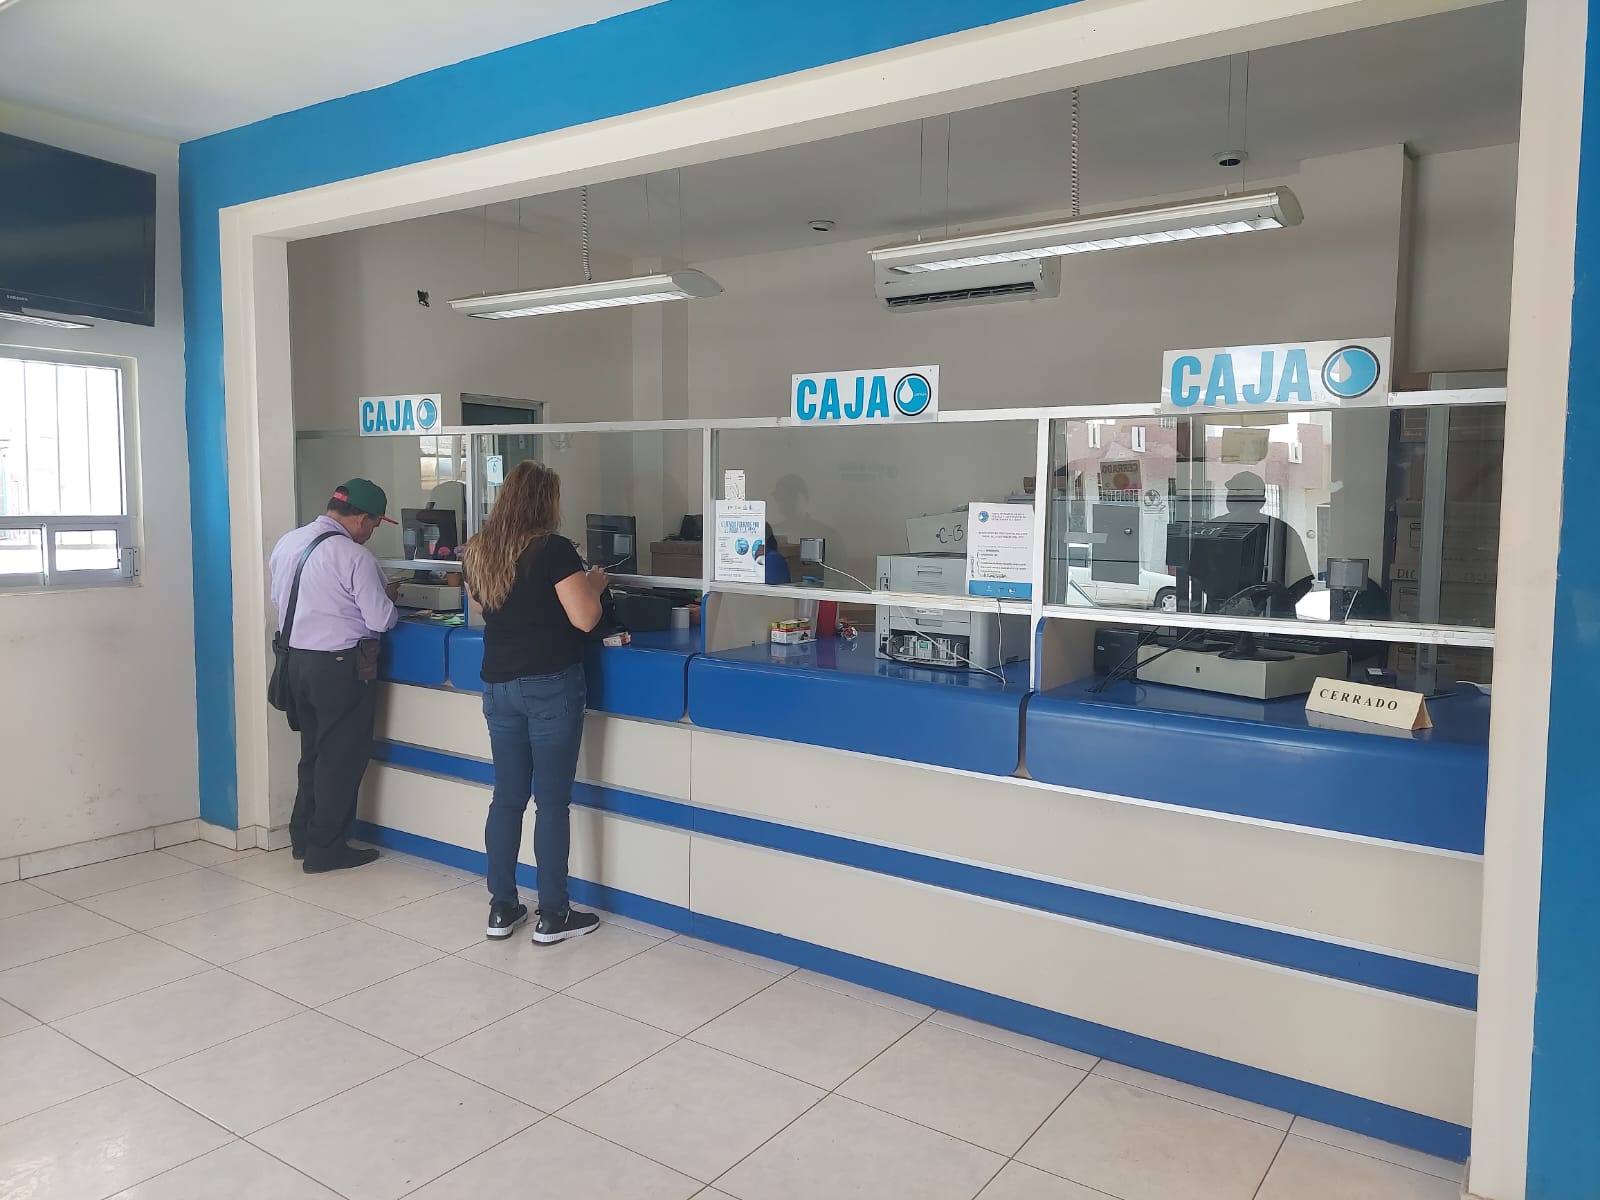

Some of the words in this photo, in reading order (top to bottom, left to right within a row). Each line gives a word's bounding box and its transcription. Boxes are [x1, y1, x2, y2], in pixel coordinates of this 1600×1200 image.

[796, 375, 890, 421] CAJA
[1171, 349, 1312, 407] CAJA
[362, 399, 415, 433] CAJA
[1319, 688, 1398, 711] CERRADO
